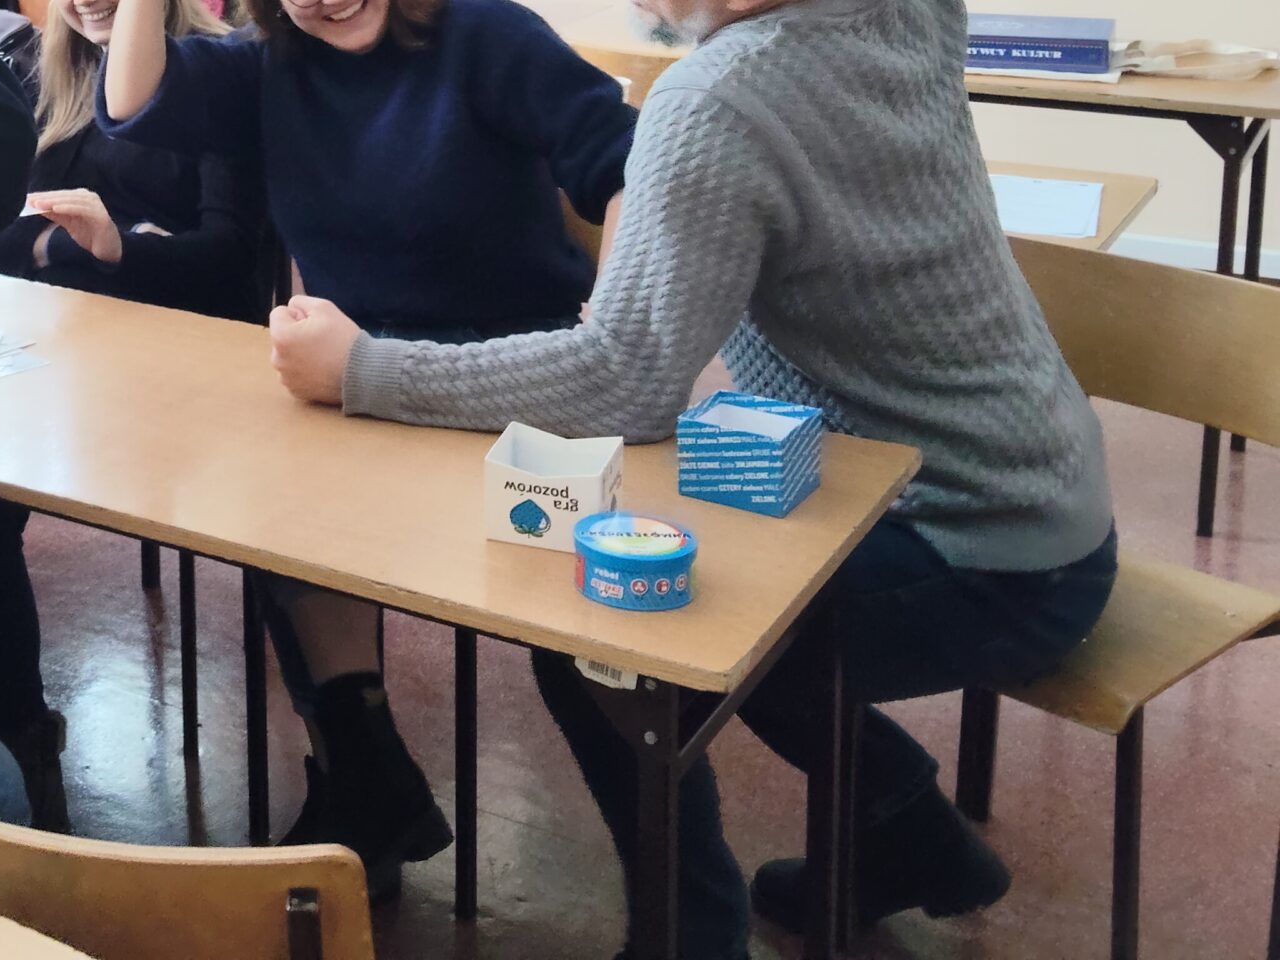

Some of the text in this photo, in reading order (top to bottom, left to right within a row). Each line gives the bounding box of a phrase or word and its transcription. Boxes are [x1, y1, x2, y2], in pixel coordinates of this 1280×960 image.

[1011, 49, 1062, 59] KULTUR
[504, 481, 569, 499] pozorów
[553, 498, 579, 512] gra
